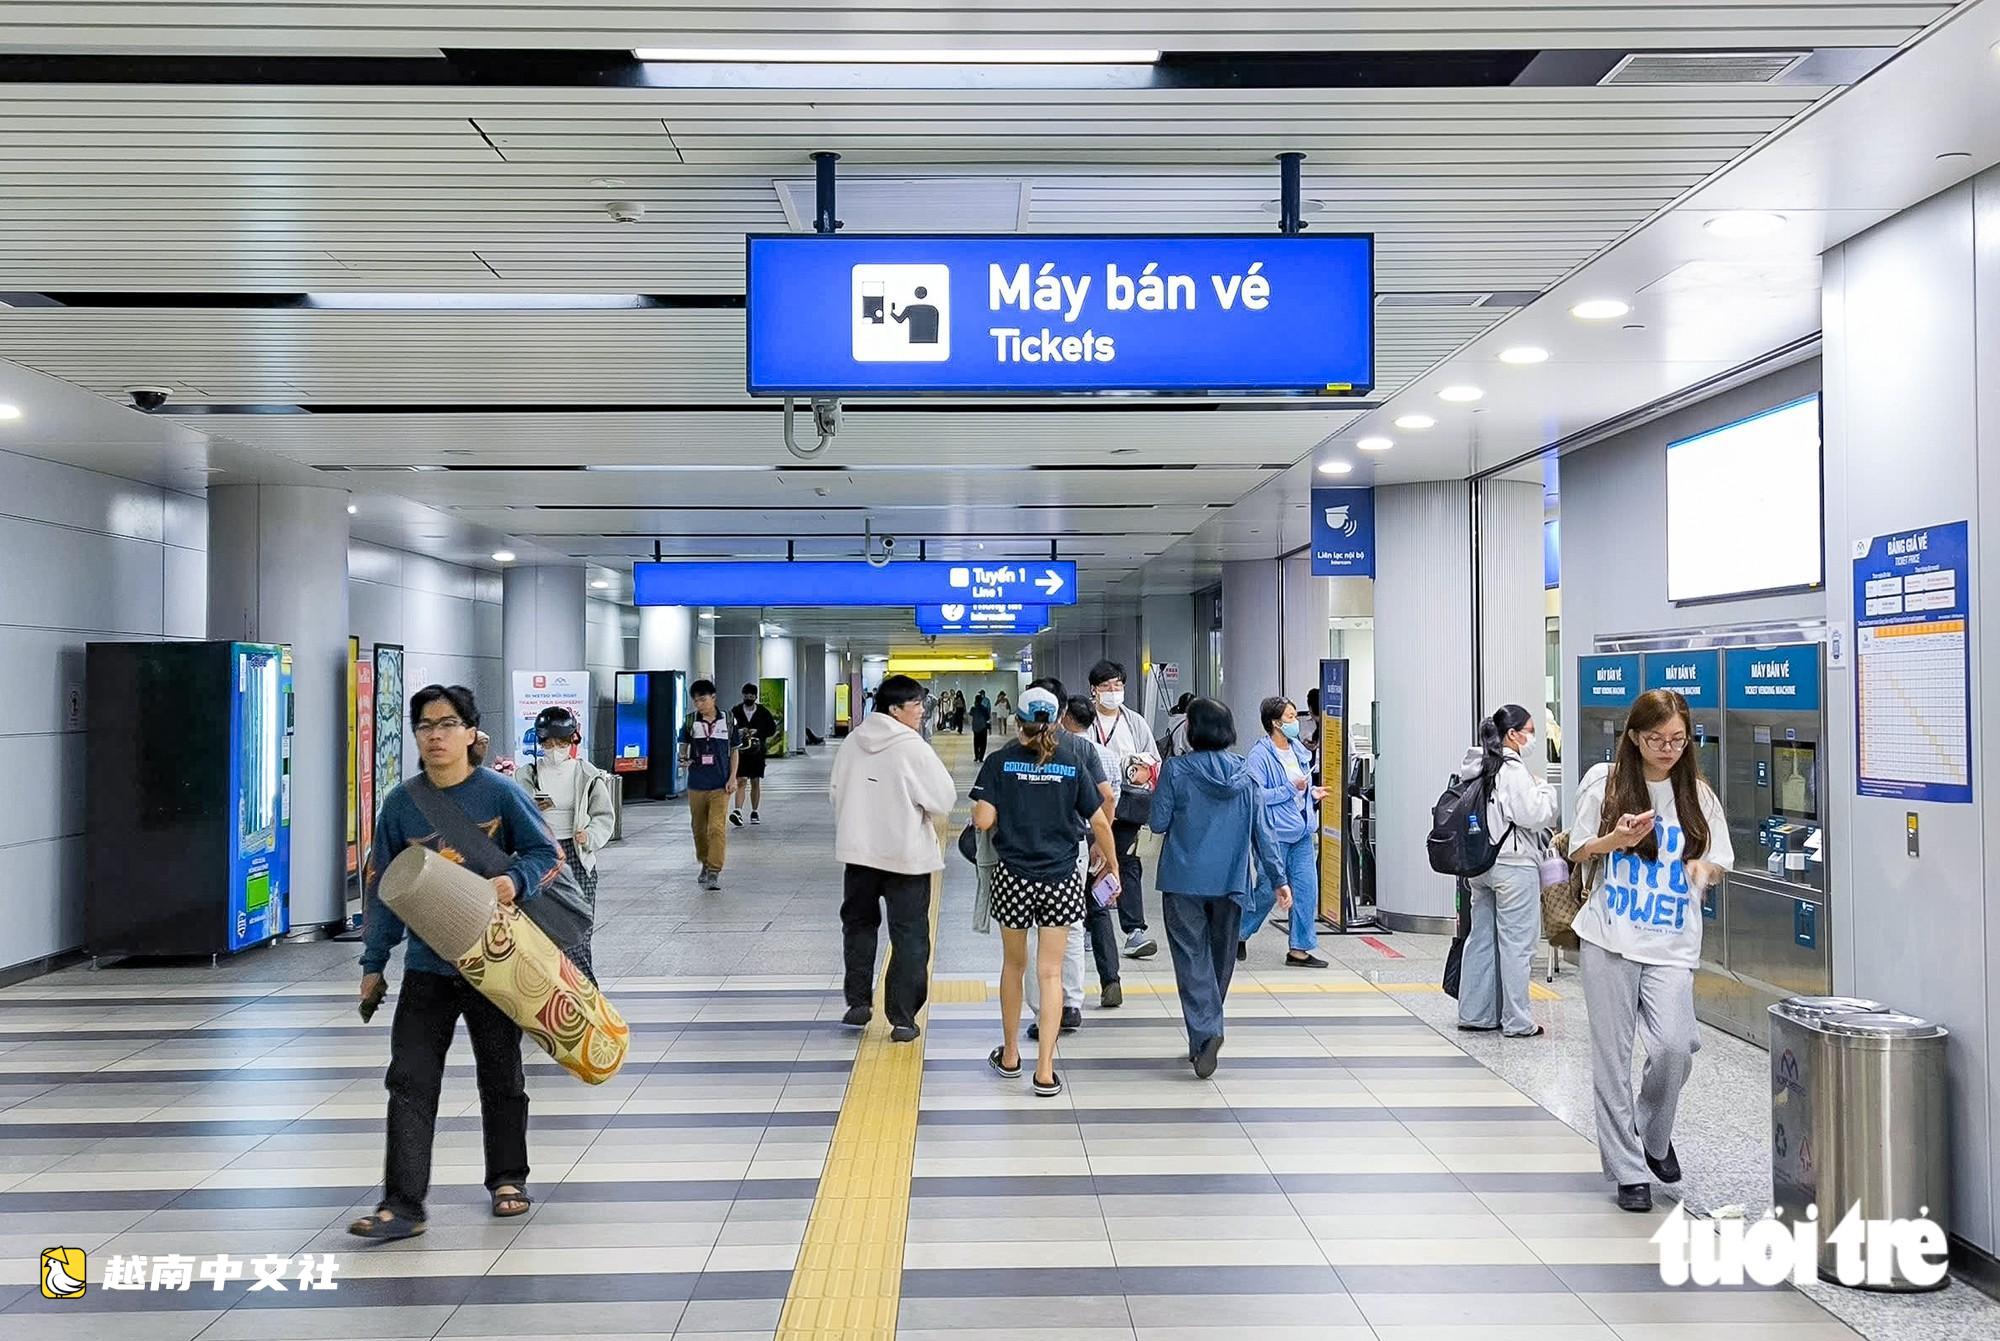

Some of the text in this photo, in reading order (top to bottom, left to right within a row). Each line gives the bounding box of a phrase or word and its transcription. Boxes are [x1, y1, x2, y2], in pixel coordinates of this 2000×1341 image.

[989, 262, 1270, 322] Máy bán vé
[989, 327, 1116, 363] Tickets
[972, 565, 1026, 587] Tuyến 1
[972, 586, 1003, 598] Line 1
[1751, 661, 1765, 678] MÁY
